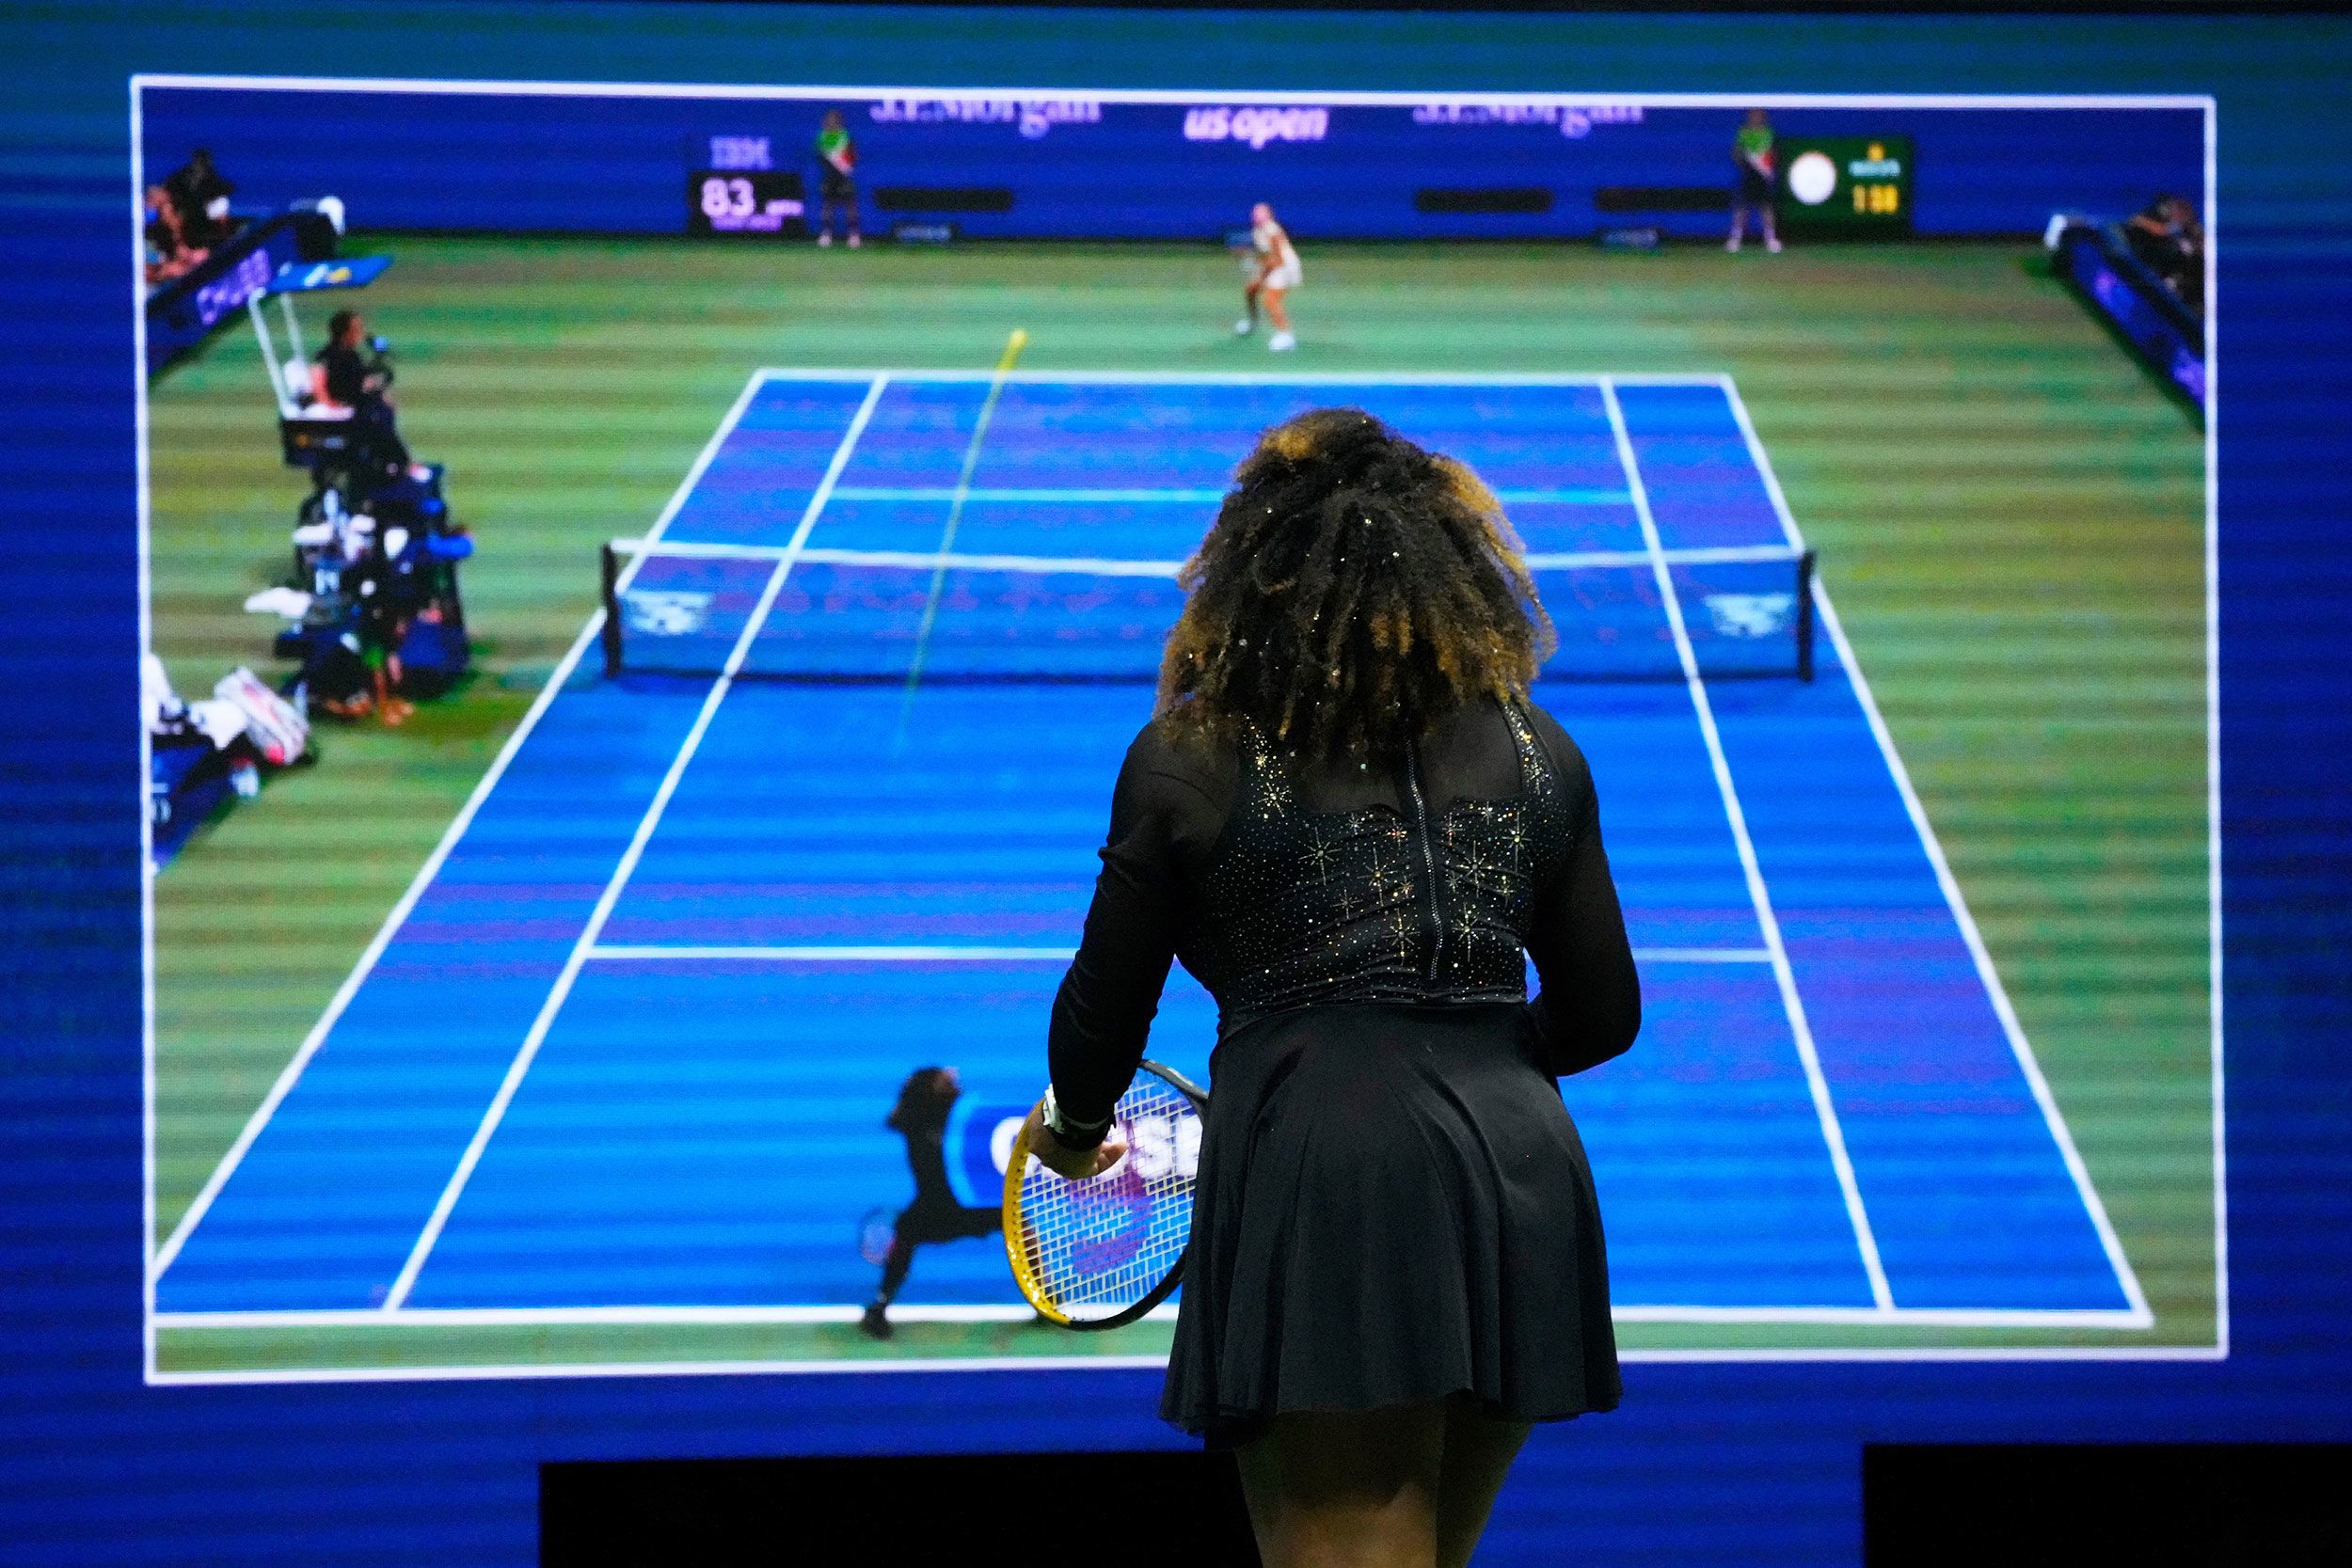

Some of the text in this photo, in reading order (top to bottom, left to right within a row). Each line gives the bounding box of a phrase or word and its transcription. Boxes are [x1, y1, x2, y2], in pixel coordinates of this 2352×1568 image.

[1184, 107, 1327, 150] us open
[702, 178, 755, 216] 83
[991, 1116, 1203, 1182] CSE
